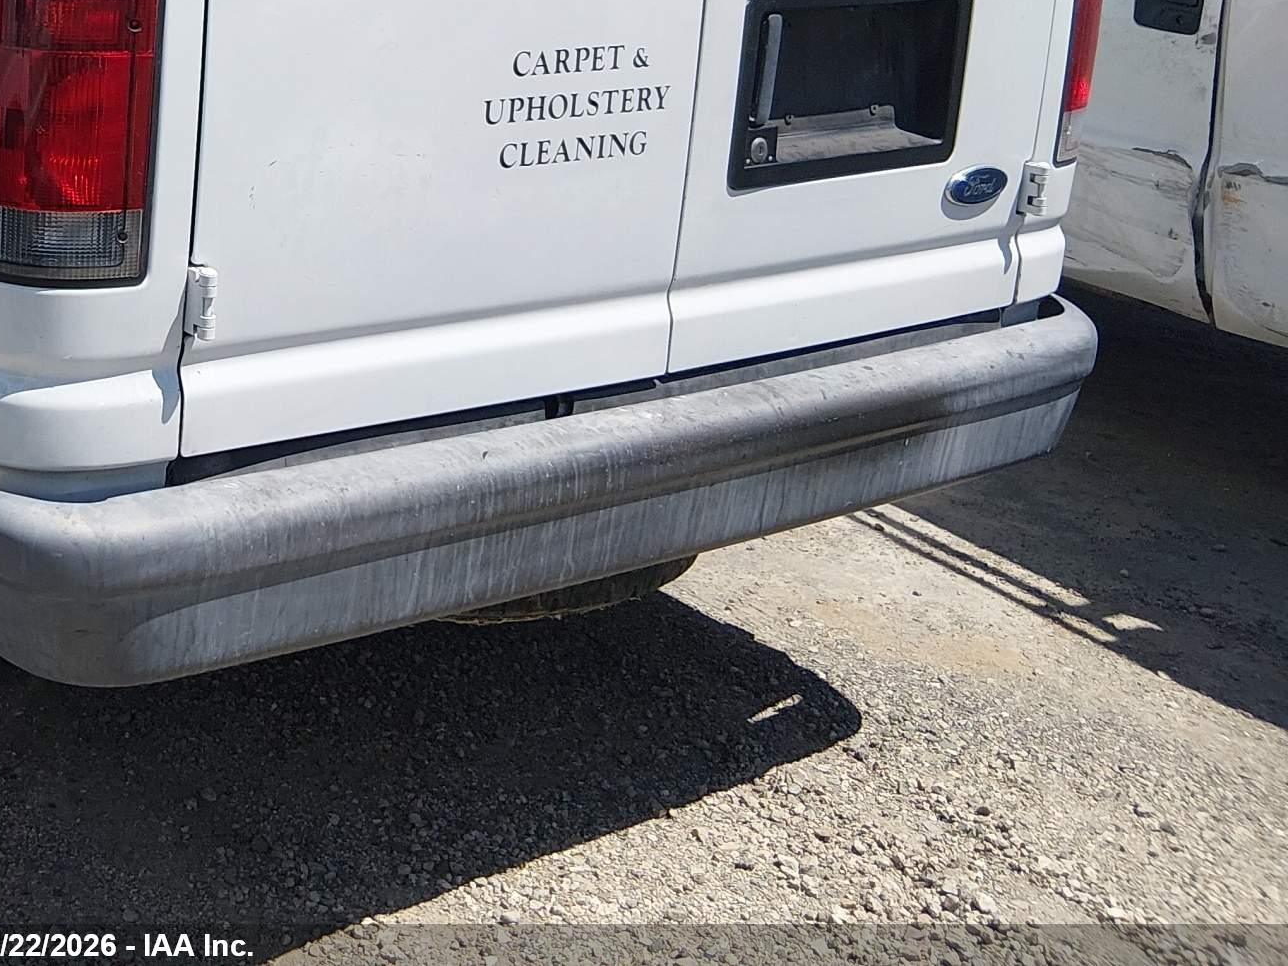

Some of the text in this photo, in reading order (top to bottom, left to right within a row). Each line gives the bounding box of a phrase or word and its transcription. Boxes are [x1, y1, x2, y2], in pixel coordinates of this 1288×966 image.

[512, 45, 650, 77] CARPET &
[483, 85, 672, 125] UPHOLSTERY
[499, 131, 649, 169] CLEANING
